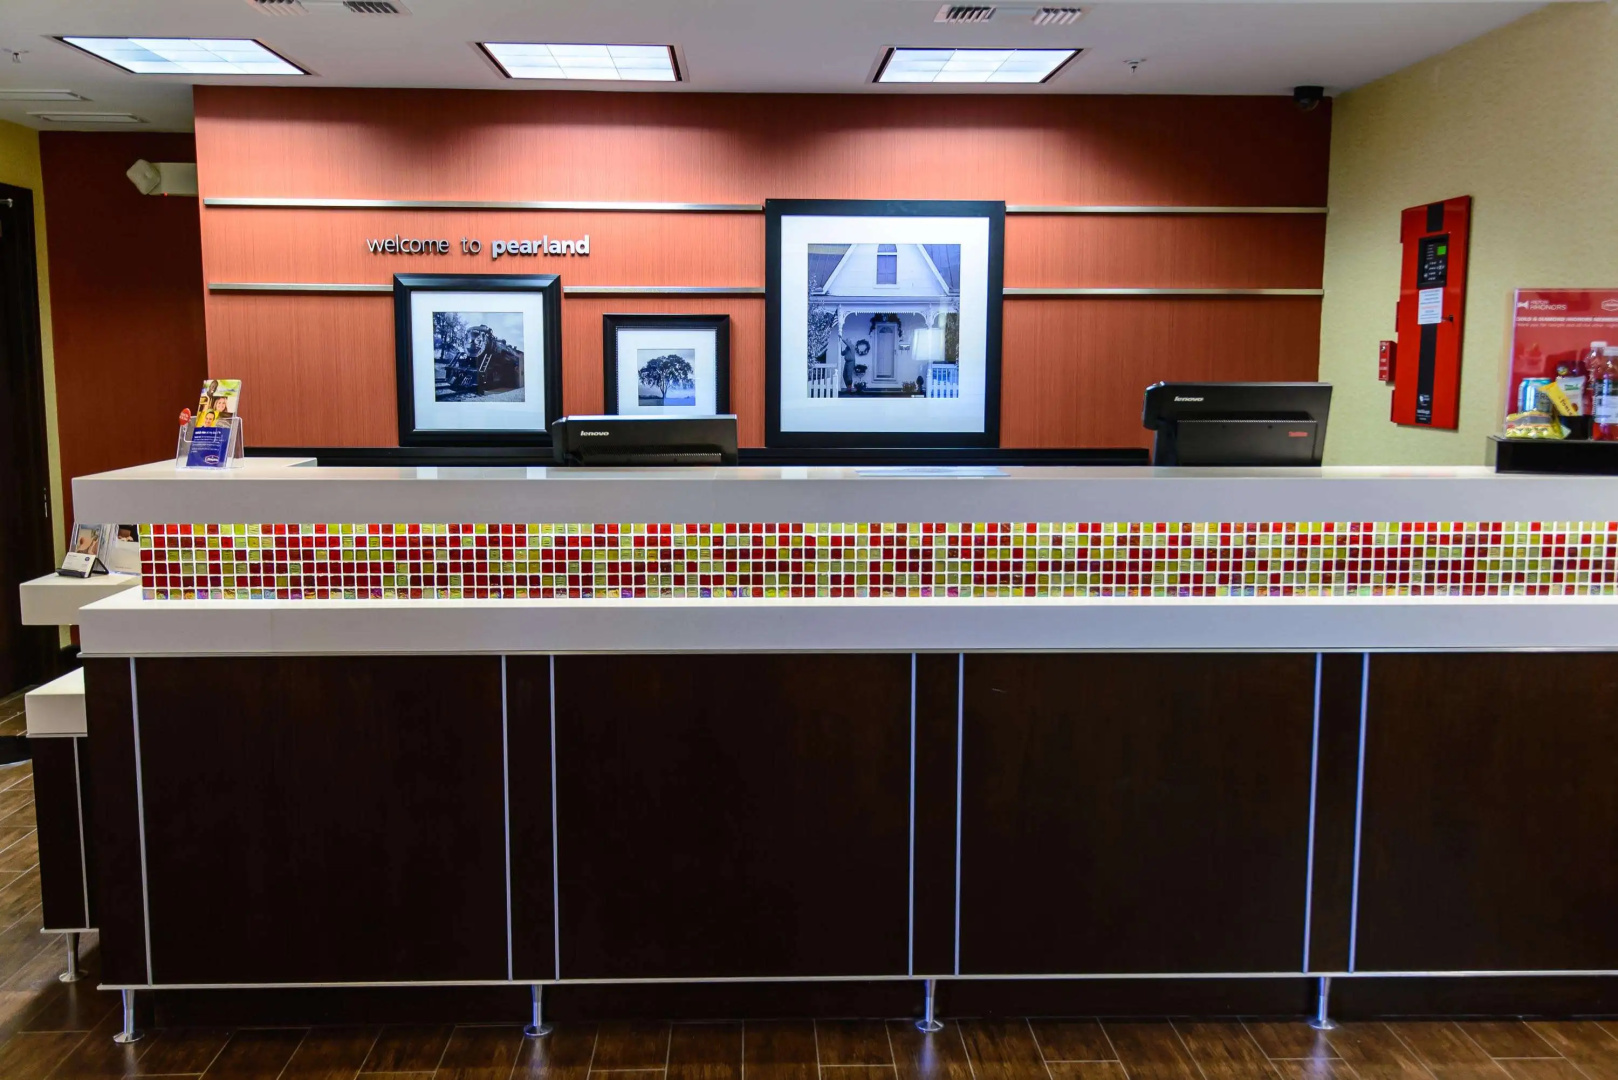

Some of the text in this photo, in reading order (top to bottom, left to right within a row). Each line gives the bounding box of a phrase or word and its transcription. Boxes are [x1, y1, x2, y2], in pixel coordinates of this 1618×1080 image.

[366, 234, 590, 258] welcome to pearland
